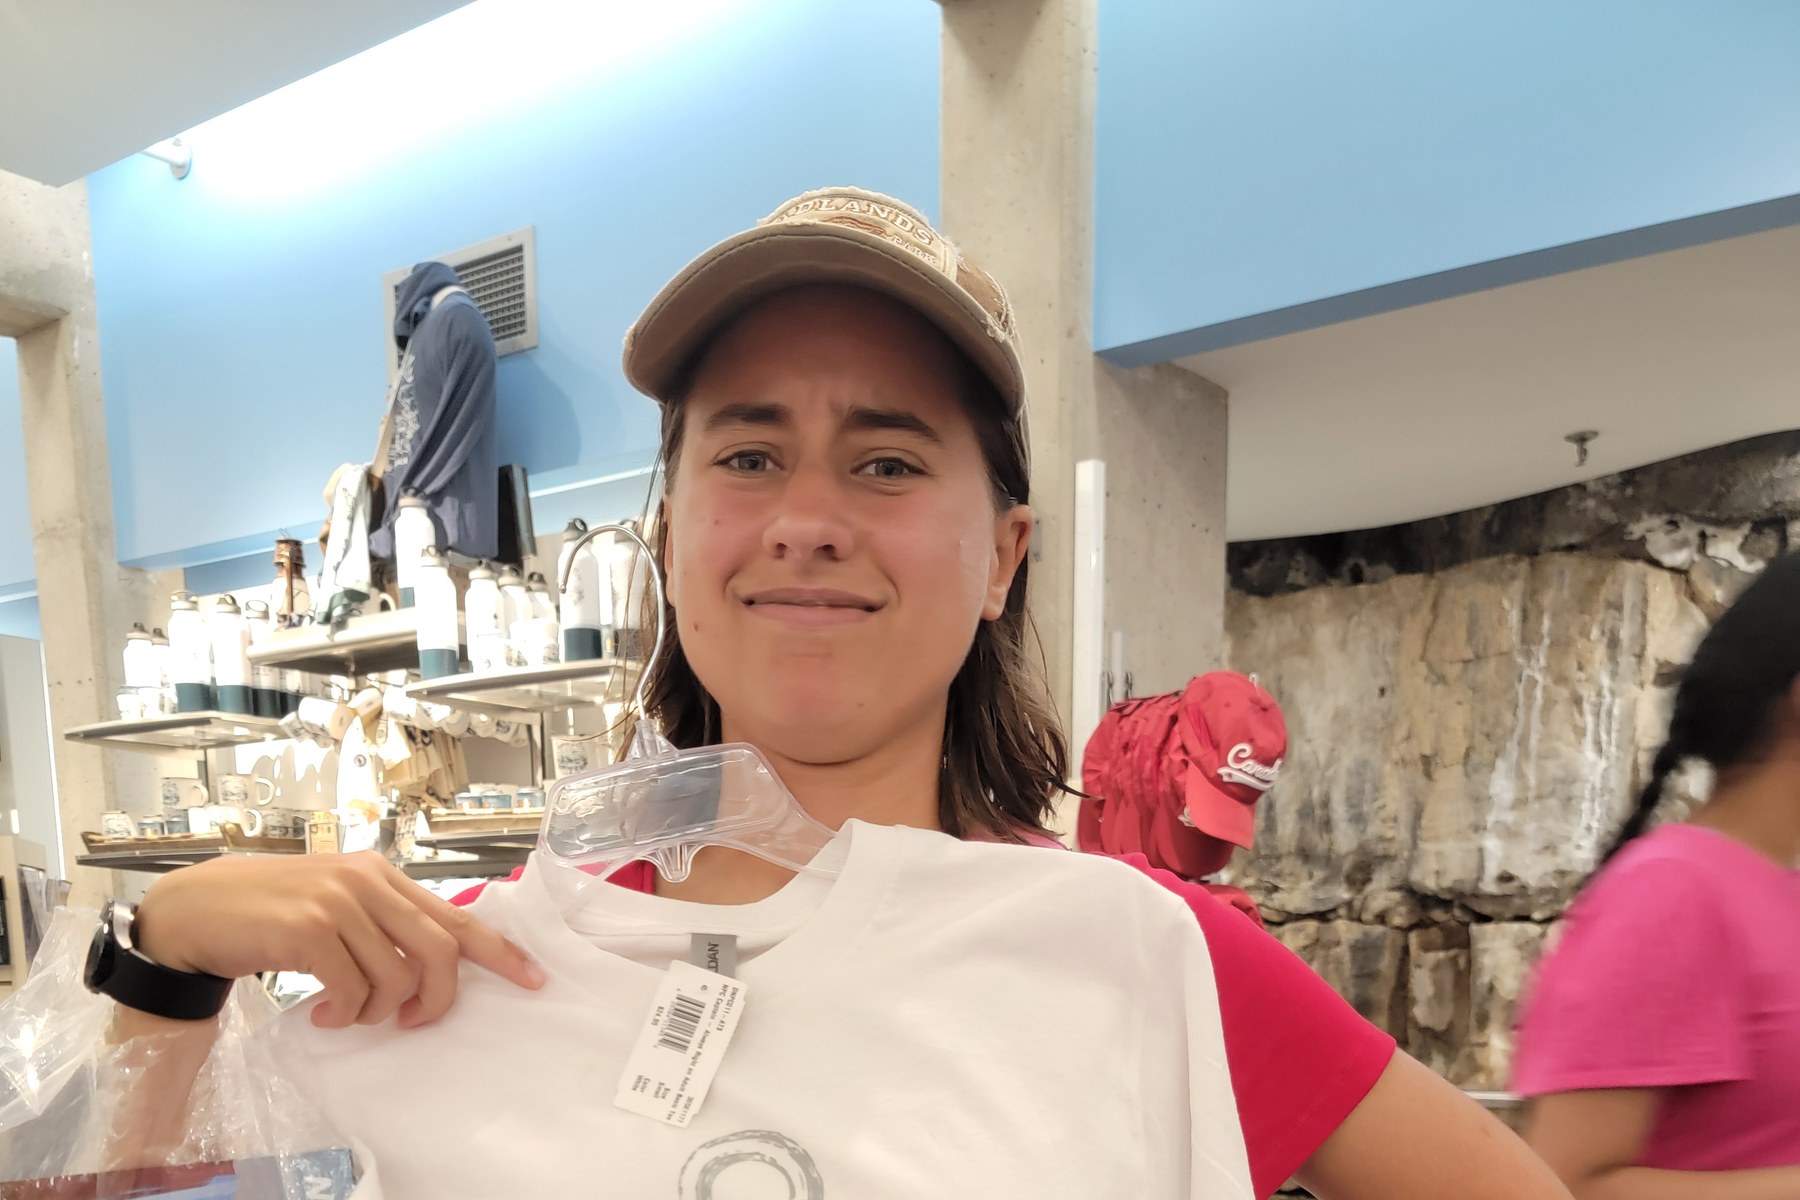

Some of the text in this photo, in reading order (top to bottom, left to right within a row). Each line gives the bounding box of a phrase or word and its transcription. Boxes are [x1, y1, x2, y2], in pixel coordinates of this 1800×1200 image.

[781, 198, 934, 246] DLANDS
[890, 234, 938, 264] PARK
[707, 997, 722, 1020] Captain
[696, 1028, 710, 1050] Always
[688, 1050, 700, 1067] Right
[678, 1076, 690, 1092] Adult
